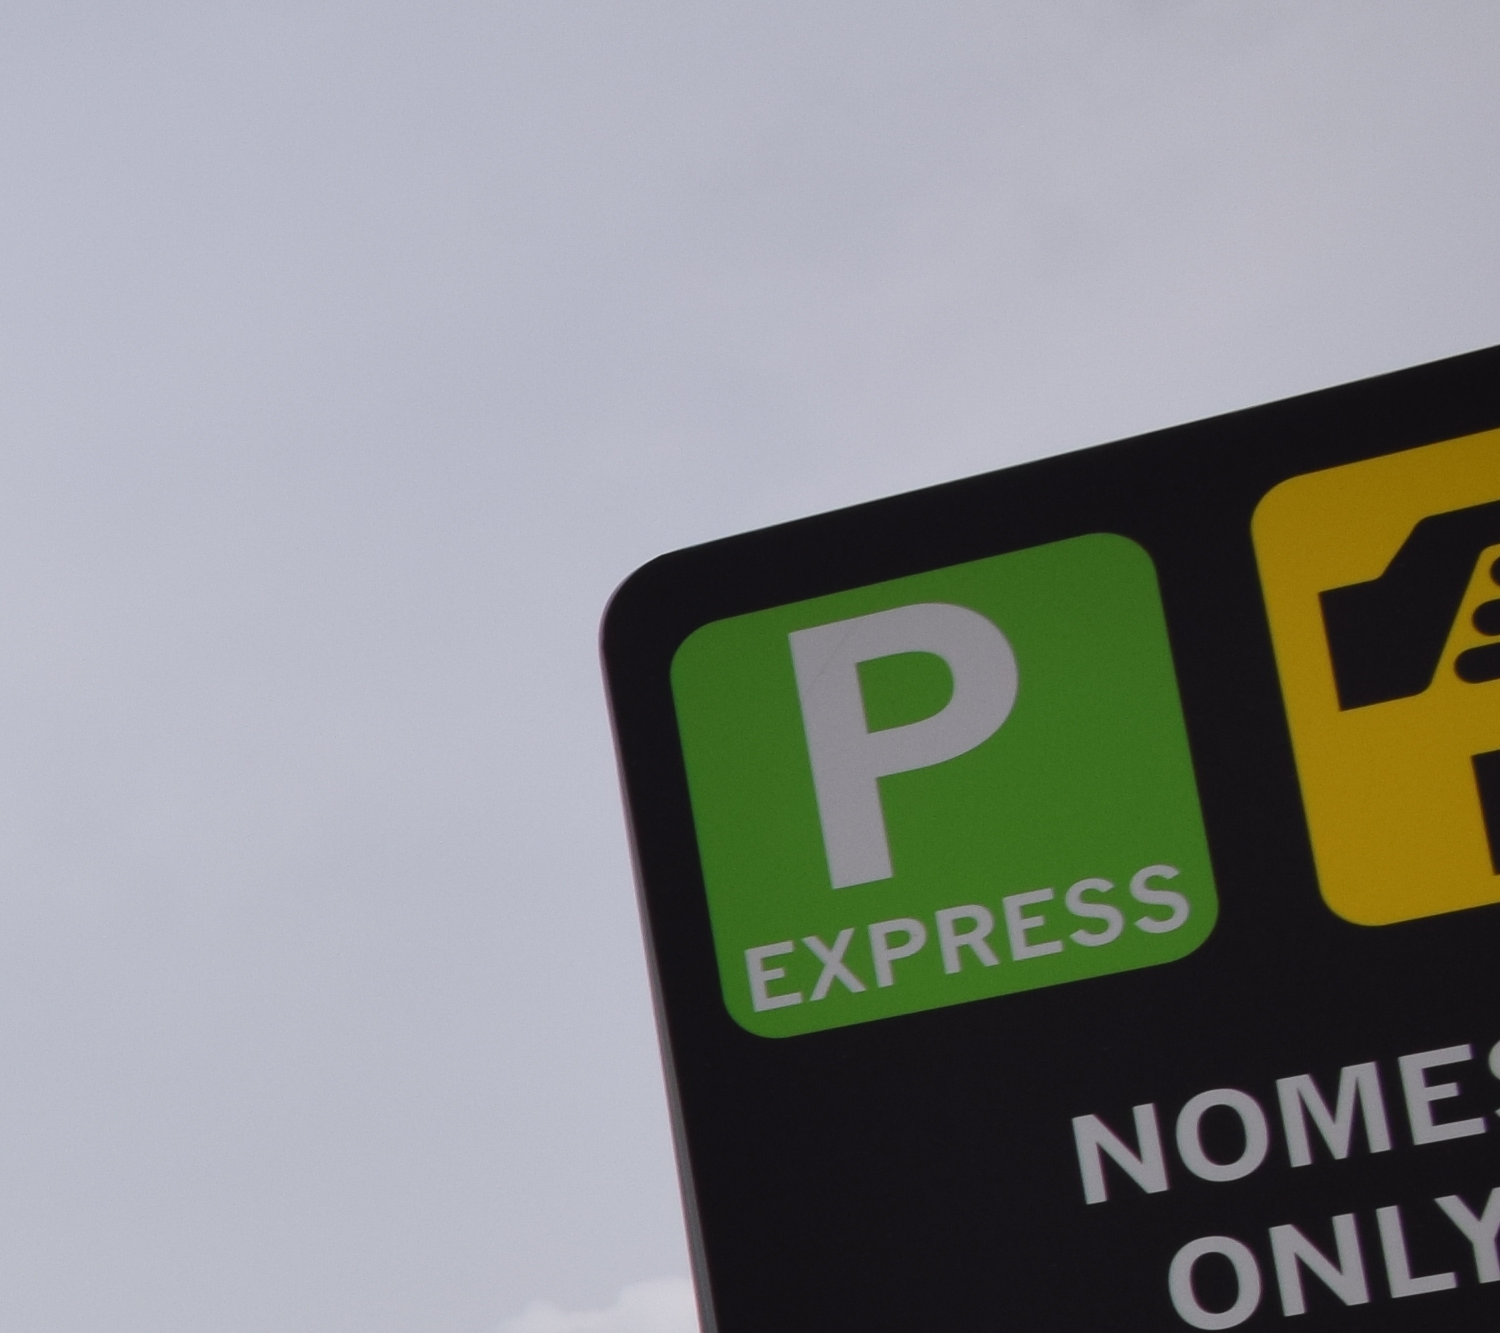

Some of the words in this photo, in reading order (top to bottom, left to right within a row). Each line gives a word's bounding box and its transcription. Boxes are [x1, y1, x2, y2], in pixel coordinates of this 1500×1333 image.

[788, 602, 1019, 890] P
[744, 863, 1192, 1013] EXPRESS
[1071, 1038, 1500, 1206] NOME
[1167, 1186, 1500, 1332] ONLY
